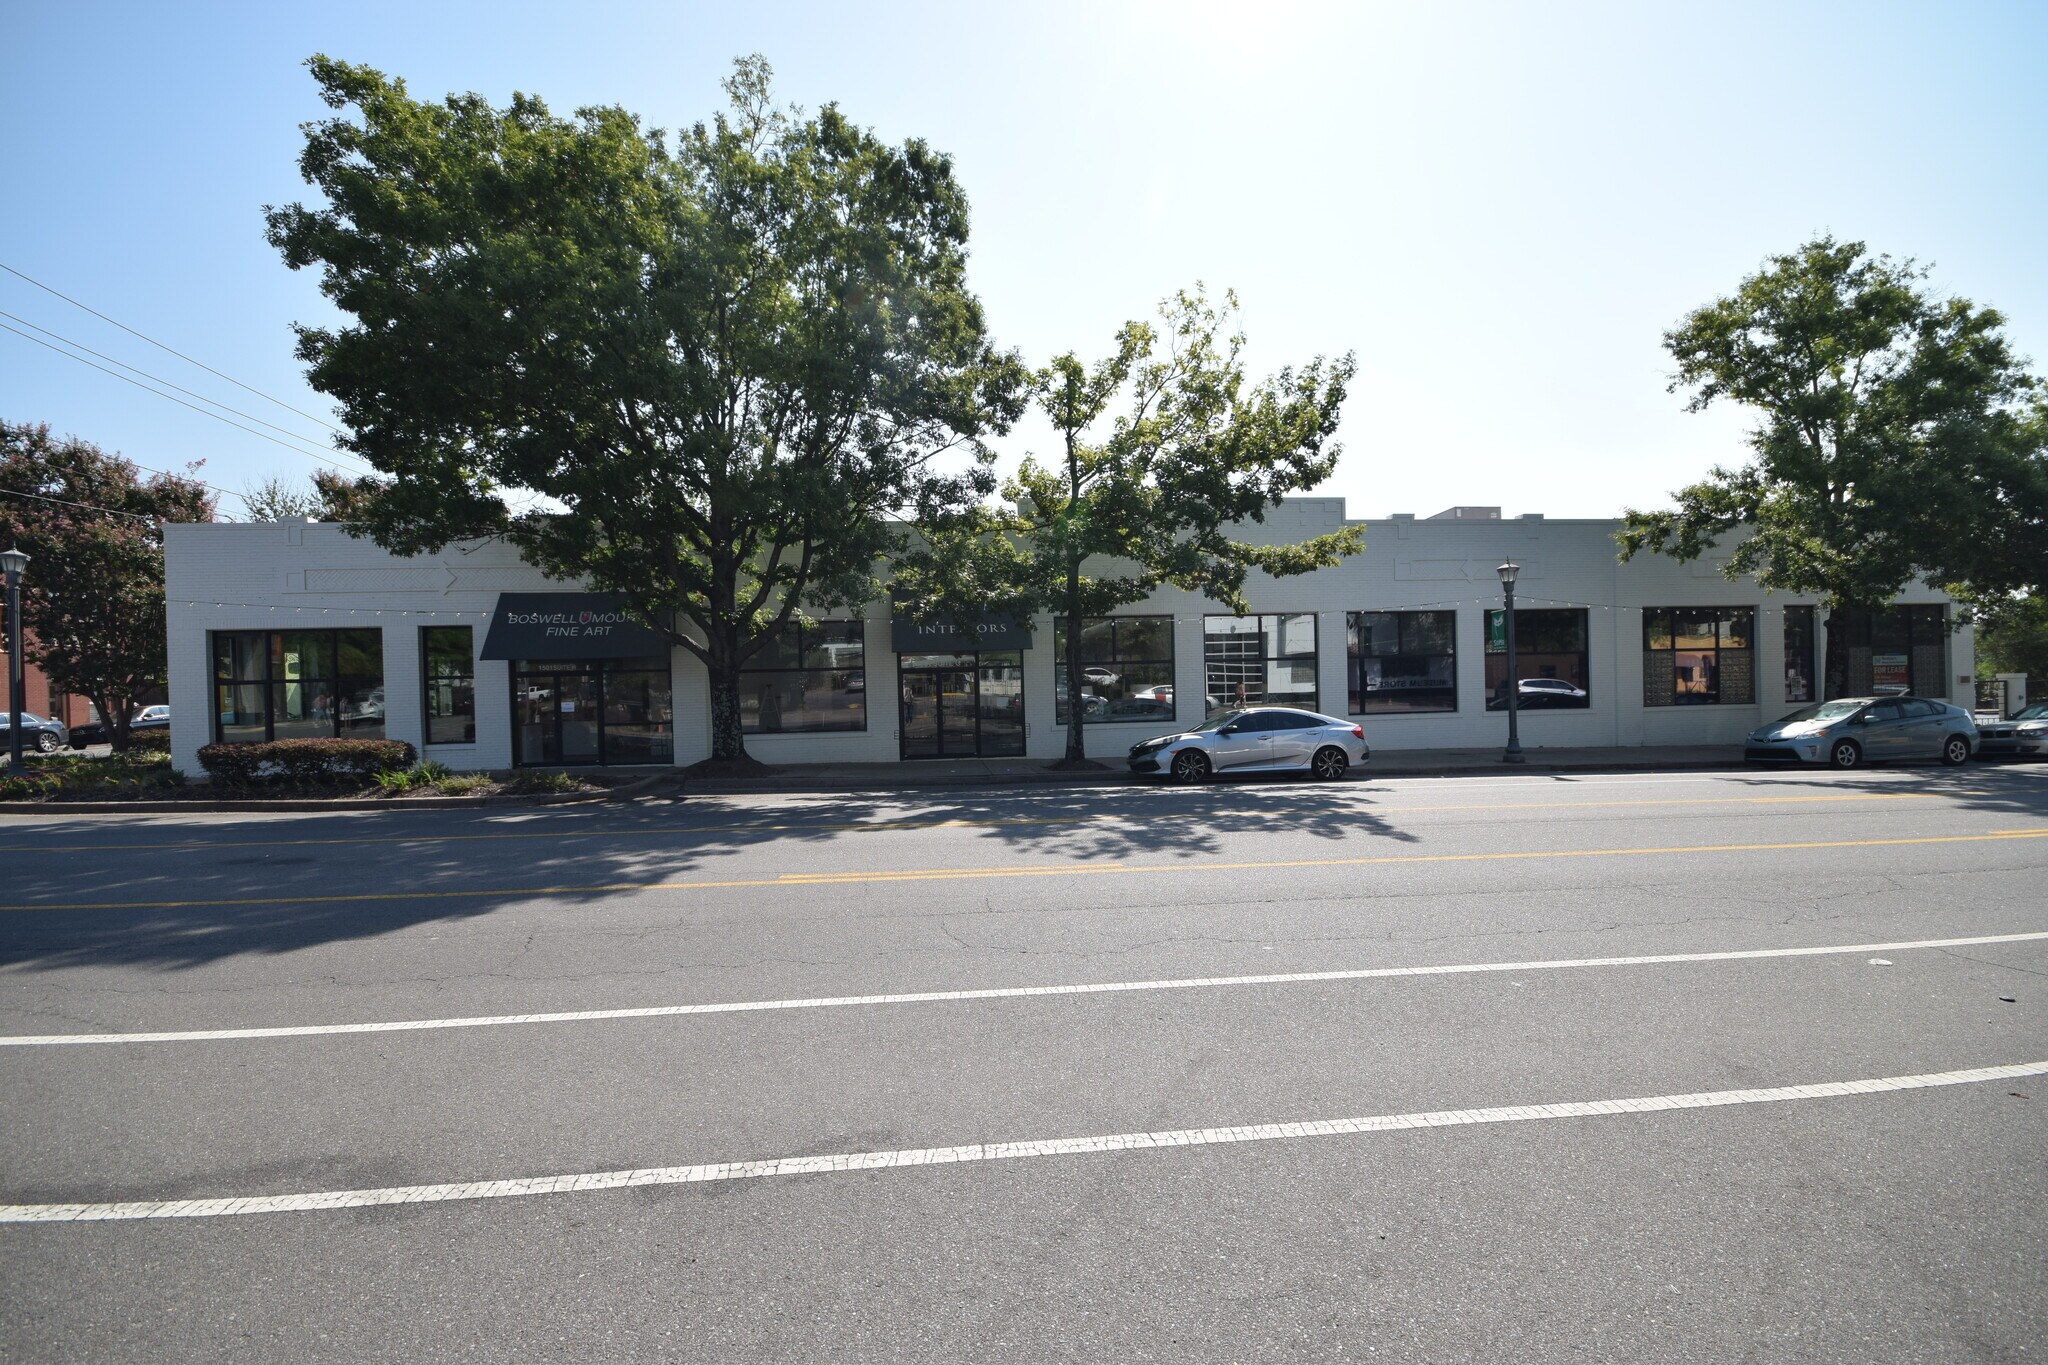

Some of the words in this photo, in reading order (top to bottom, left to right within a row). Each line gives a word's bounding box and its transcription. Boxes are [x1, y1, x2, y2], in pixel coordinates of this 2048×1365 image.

[508, 614, 577, 624] BOSWELL
[546, 626, 579, 636] FINE
[583, 626, 613, 636] ART
[918, 623, 1007, 634] INTEORS
[1874, 666, 1887, 674] FOR
